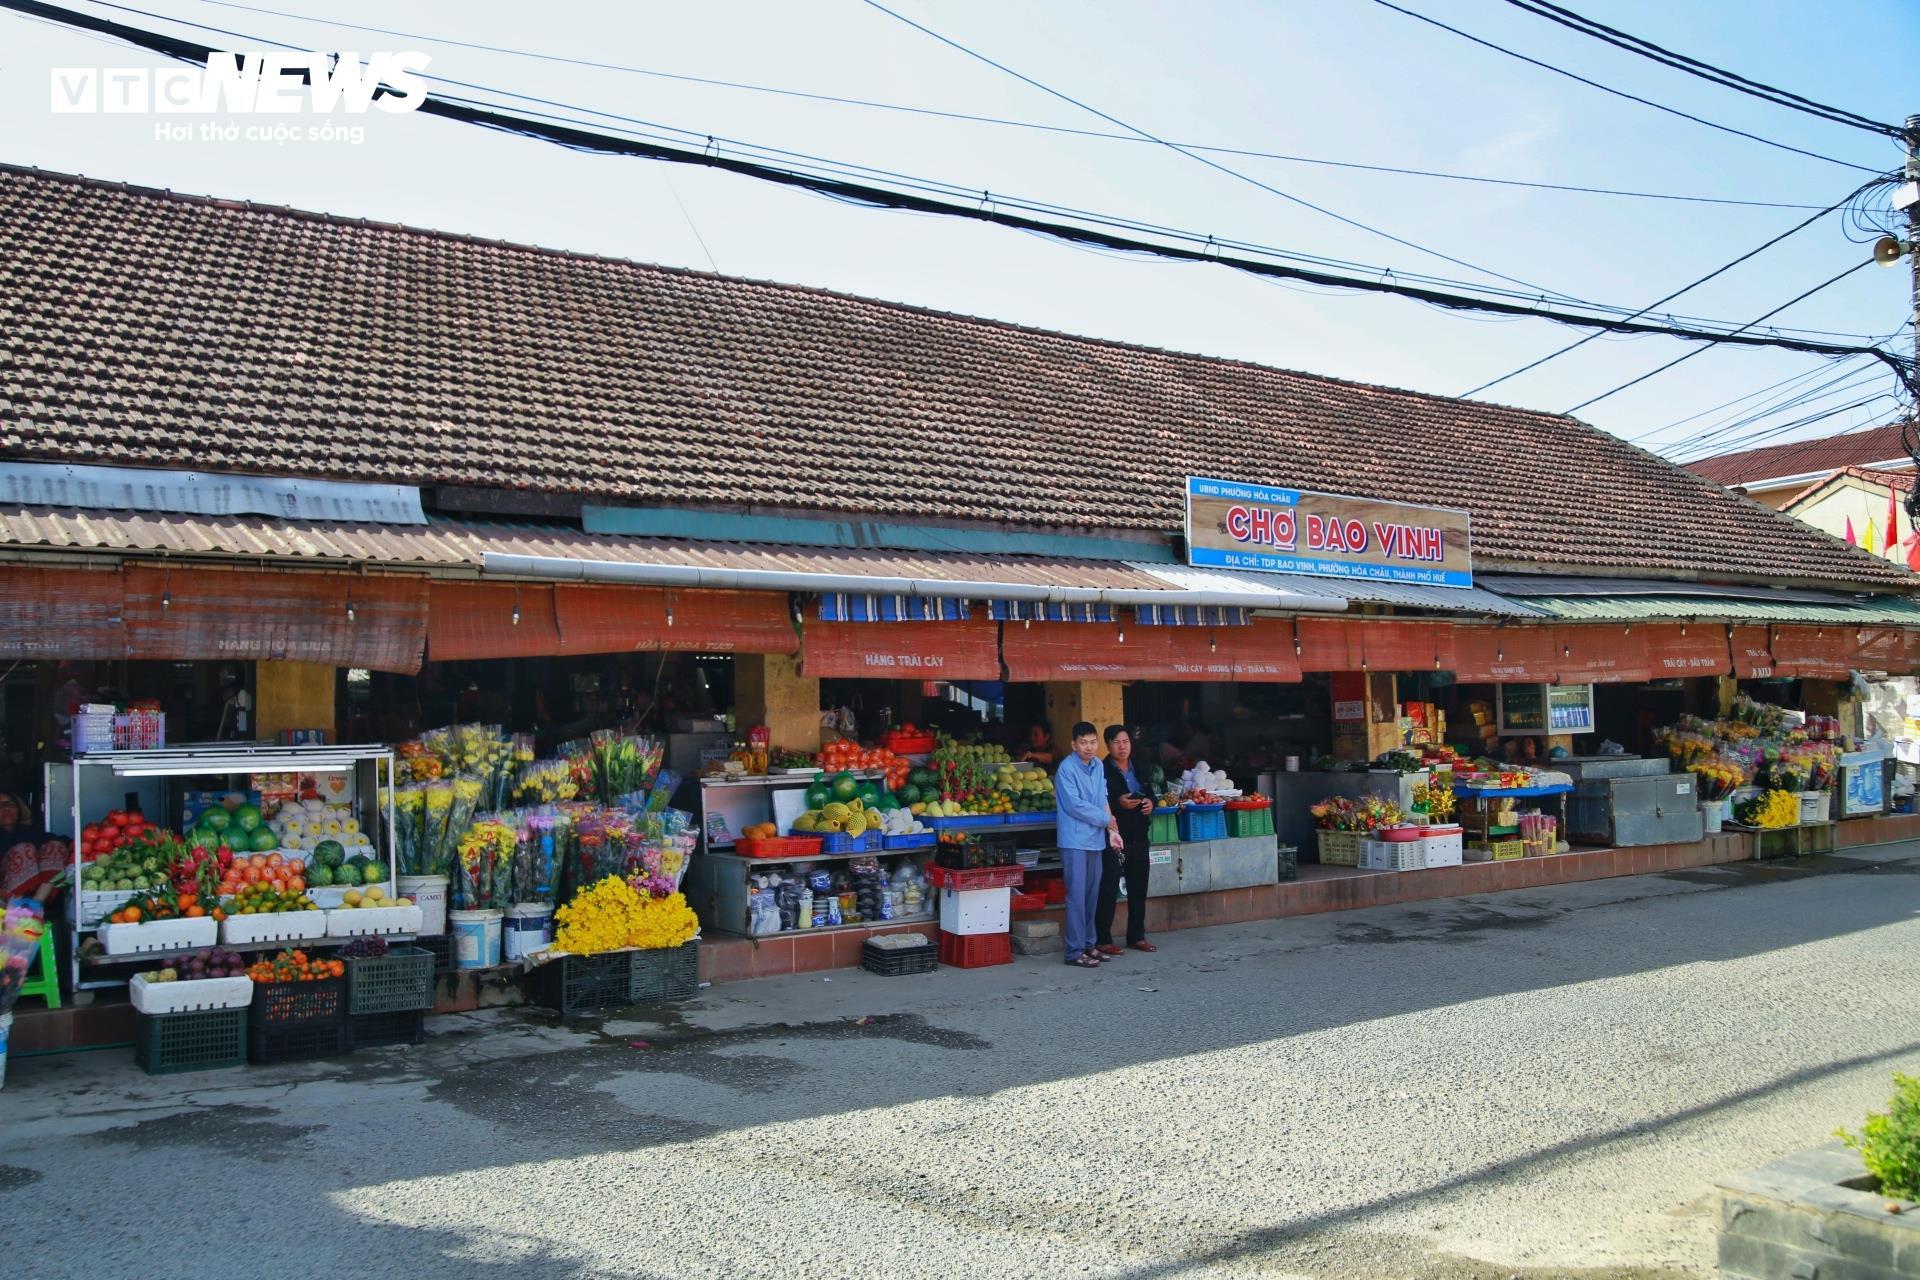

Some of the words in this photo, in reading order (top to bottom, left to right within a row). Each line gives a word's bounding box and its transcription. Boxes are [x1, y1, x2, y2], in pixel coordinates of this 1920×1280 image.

[1199, 484, 1220, 494] UBND
[1221, 486, 1252, 499] PHƯỜNG
[1271, 492, 1291, 504] CHÂU
[1226, 505, 1296, 551] CHỢ
[1306, 513, 1367, 552] BAO
[1373, 521, 1443, 561] VINH
[1225, 554, 1241, 567] ĐỊA
[1277, 559, 1294, 569] BAO
[1318, 561, 1350, 575] PHƯỜNG
[1393, 568, 1416, 580] THÀNH
[1417, 570, 1432, 581] PHỐ
[1433, 571, 1446, 583] HUẾ
[865, 652, 896, 666] HÀNG
[897, 653, 922, 667] TRÁI
[924, 654, 944, 667] CÂY
